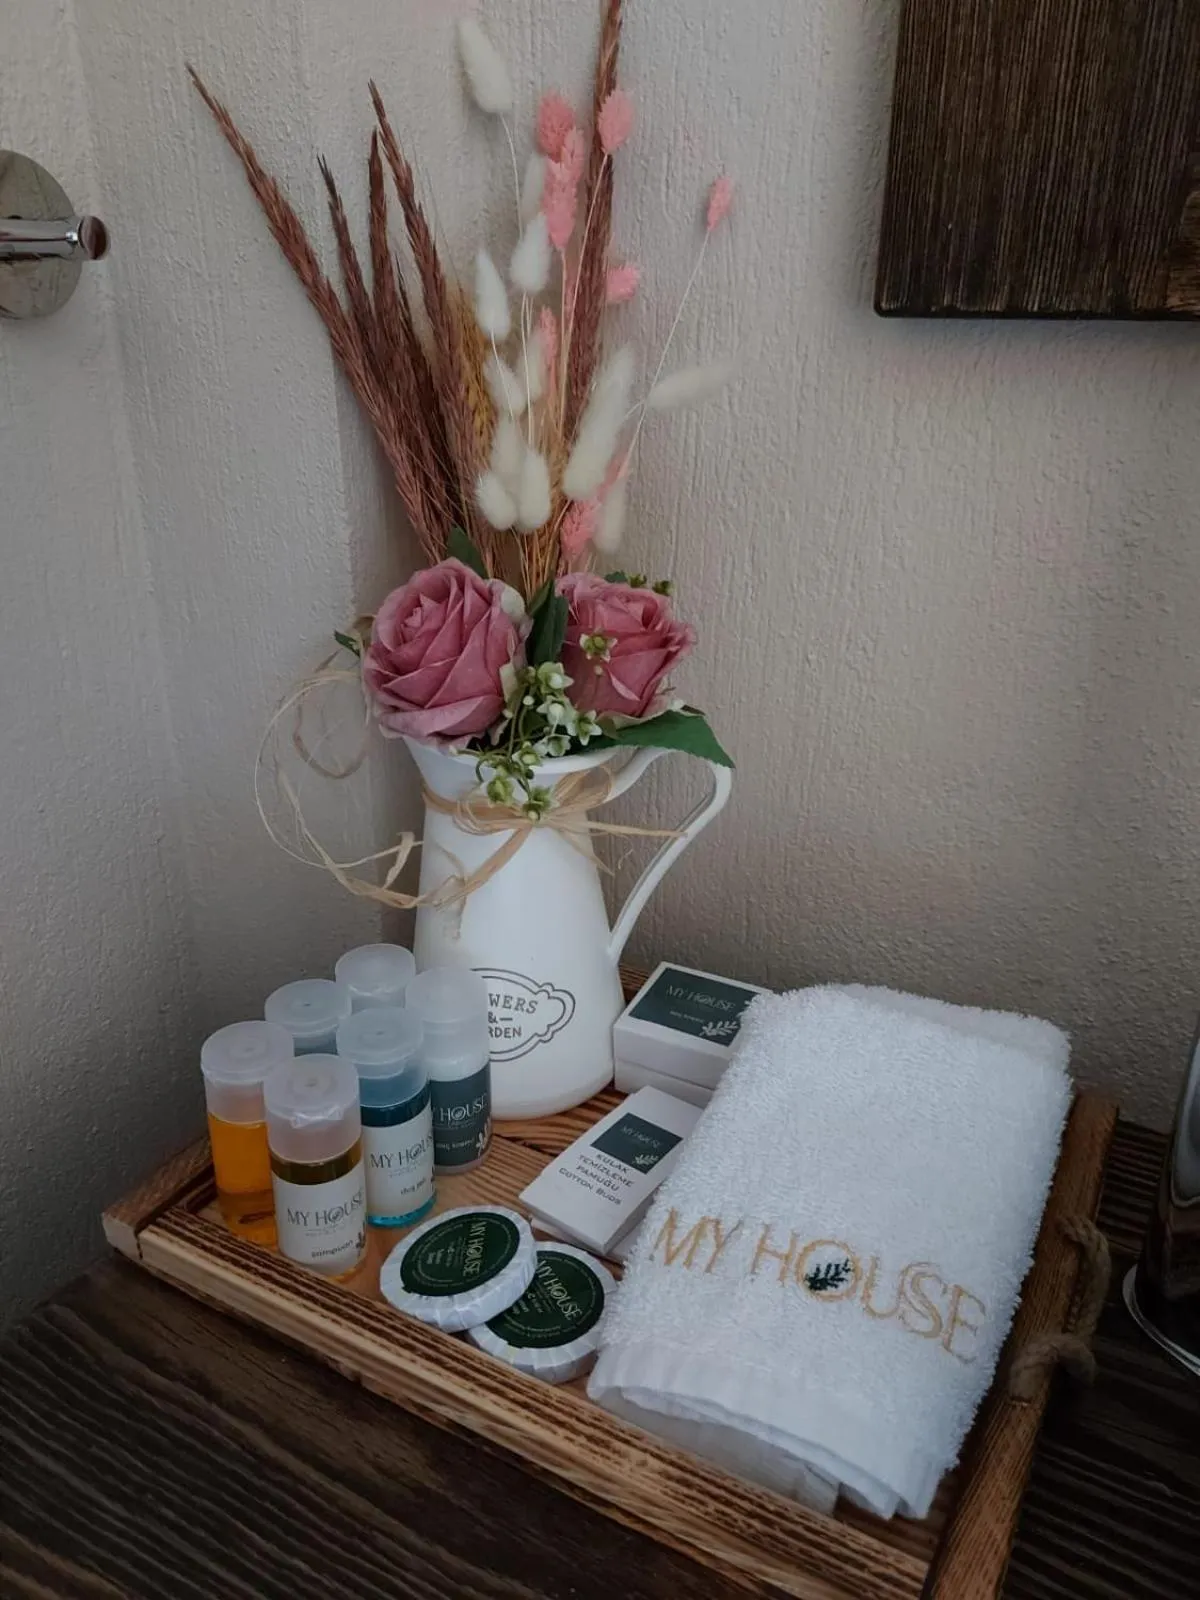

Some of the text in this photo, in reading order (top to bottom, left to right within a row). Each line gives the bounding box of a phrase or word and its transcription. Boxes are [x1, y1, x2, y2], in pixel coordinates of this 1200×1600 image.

[488, 993, 538, 1015] WERS
[488, 1026, 522, 1039] RDEN
[370, 1151, 393, 1169] MY
[596, 1154, 631, 1174] KULAK
[287, 1206, 310, 1227] MY
[648, 1206, 987, 1364] MY HOUSE
[544, 1278, 583, 1321] HOUSE
